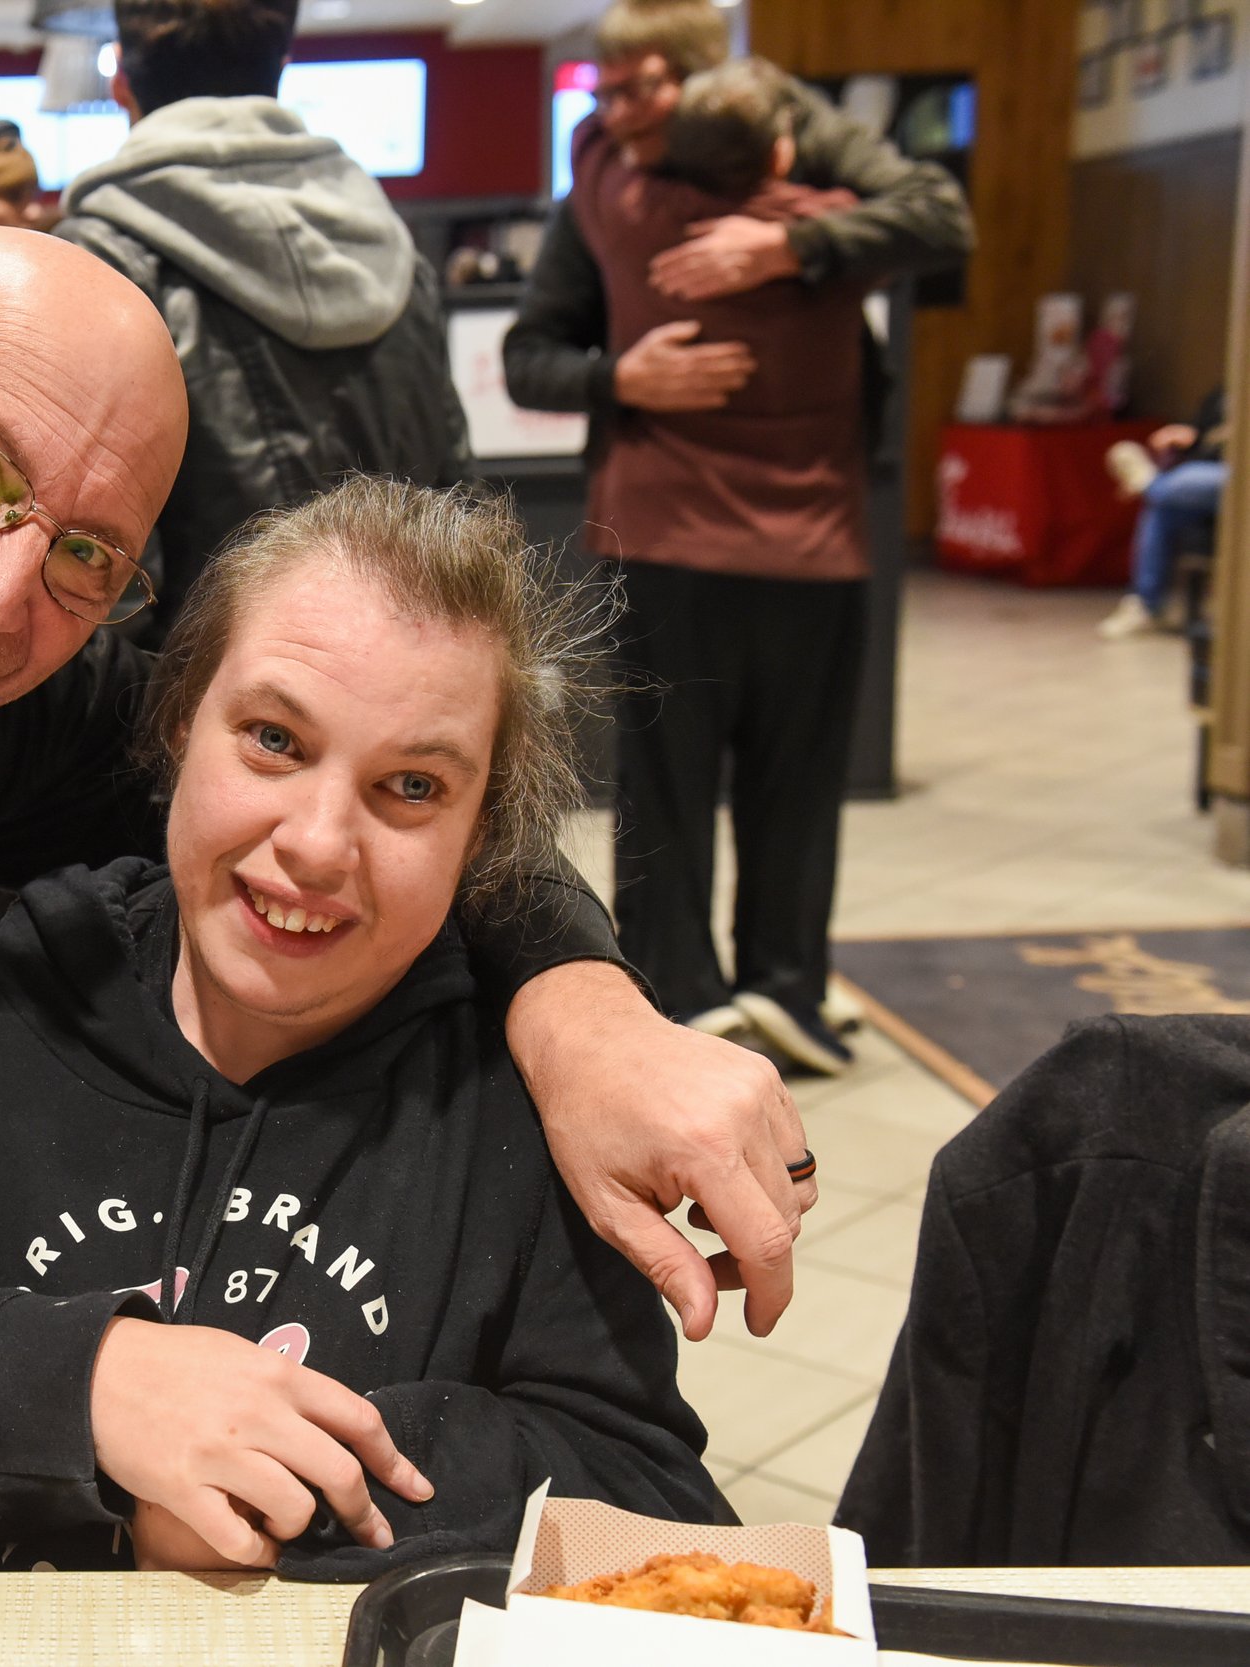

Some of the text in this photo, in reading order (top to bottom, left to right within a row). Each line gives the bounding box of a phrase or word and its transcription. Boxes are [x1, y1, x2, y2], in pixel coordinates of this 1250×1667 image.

[17, 1187, 390, 1337] RIG. BRAND
[223, 1268, 280, 1304] 87
